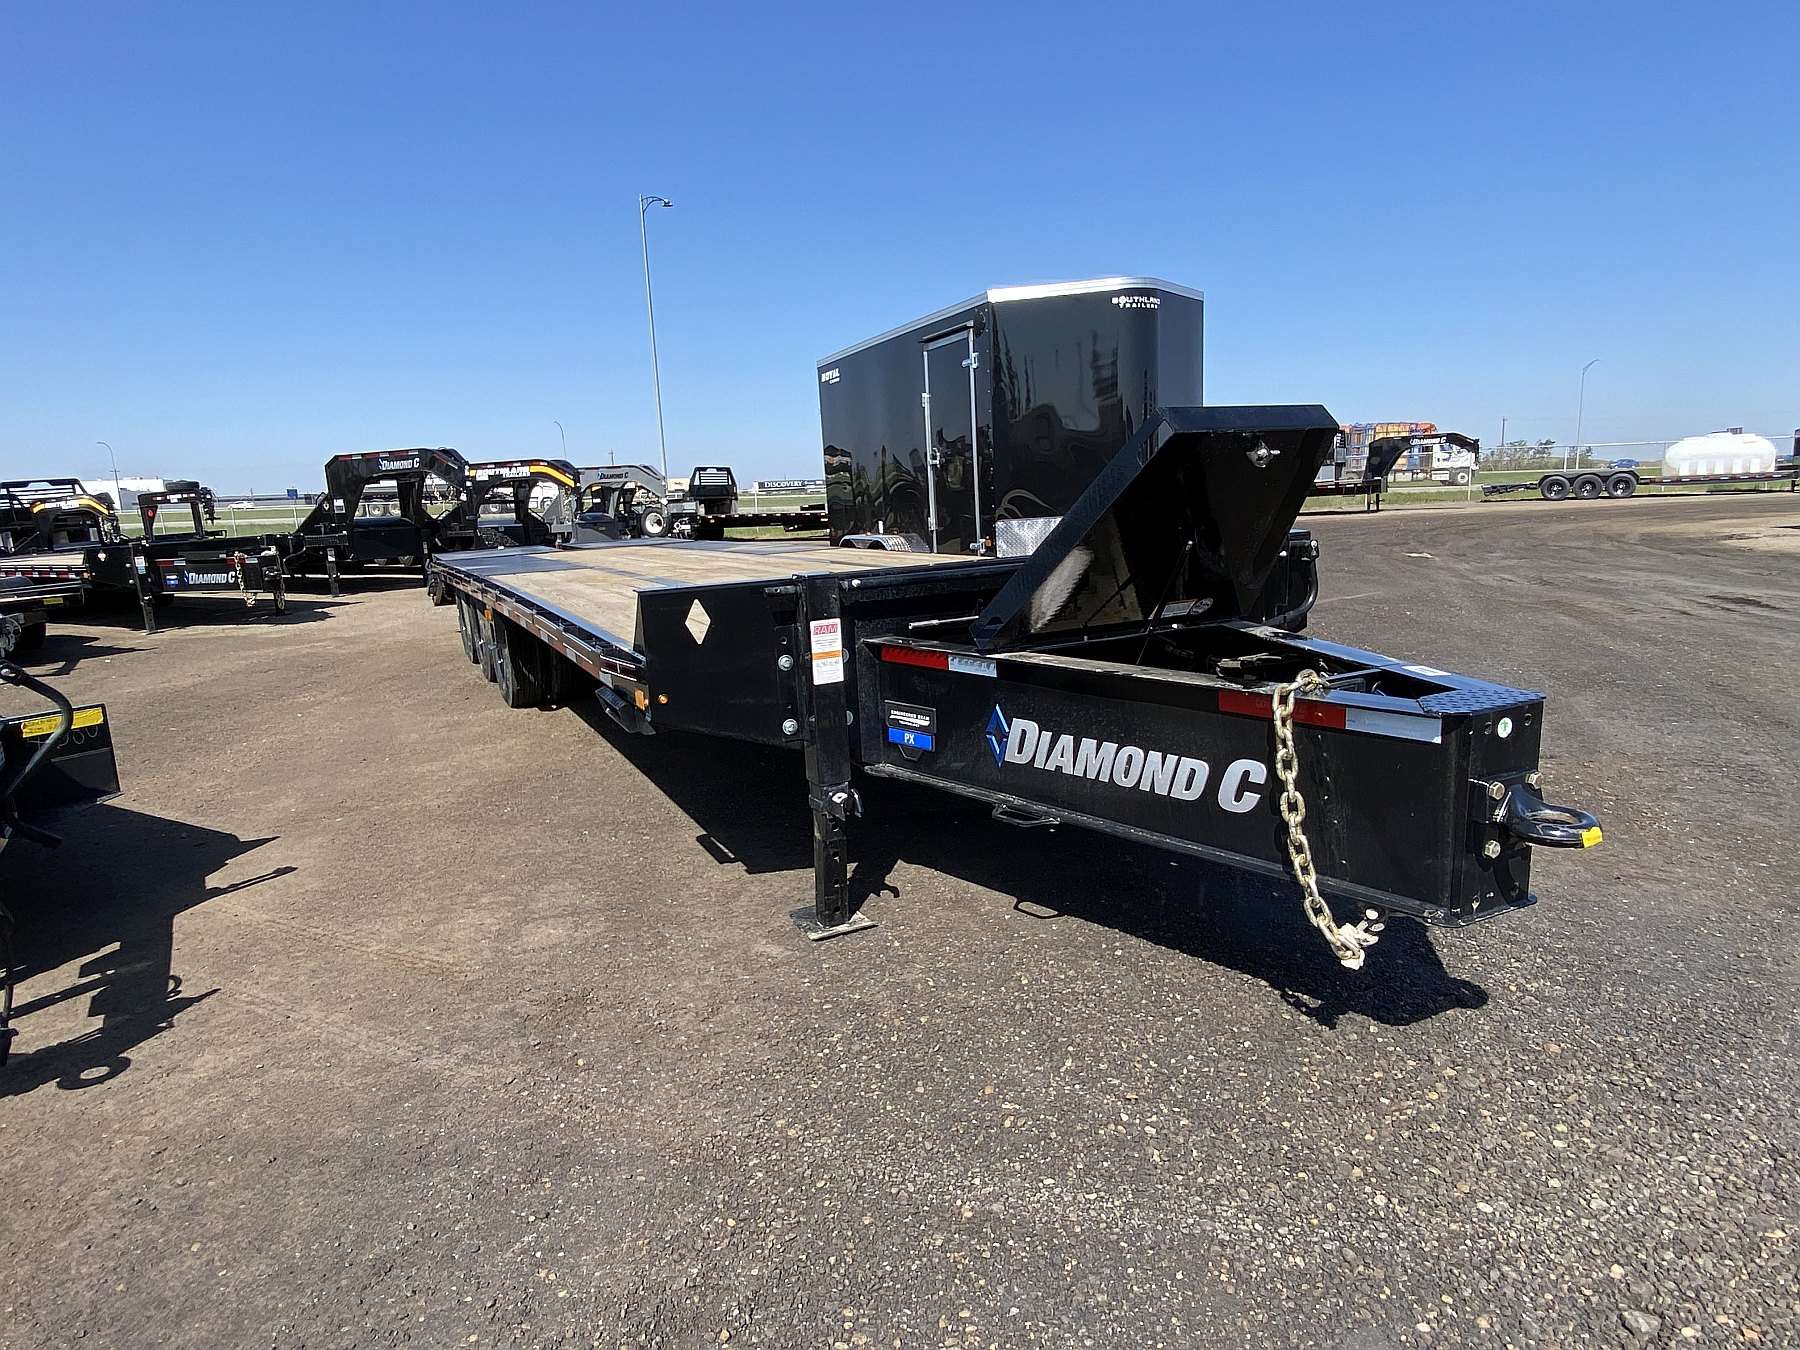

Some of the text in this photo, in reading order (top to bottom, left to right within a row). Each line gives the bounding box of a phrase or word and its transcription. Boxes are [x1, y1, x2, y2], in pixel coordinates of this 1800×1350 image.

[382, 457, 420, 470] DIAMOND C
[764, 480, 803, 488] DISCOVERY
[188, 572, 228, 585] DIAMOND
[227, 571, 236, 584] C
[813, 623, 838, 635] RAM
[904, 732, 915, 745] PX
[1004, 717, 1268, 814] DIAMOND C
